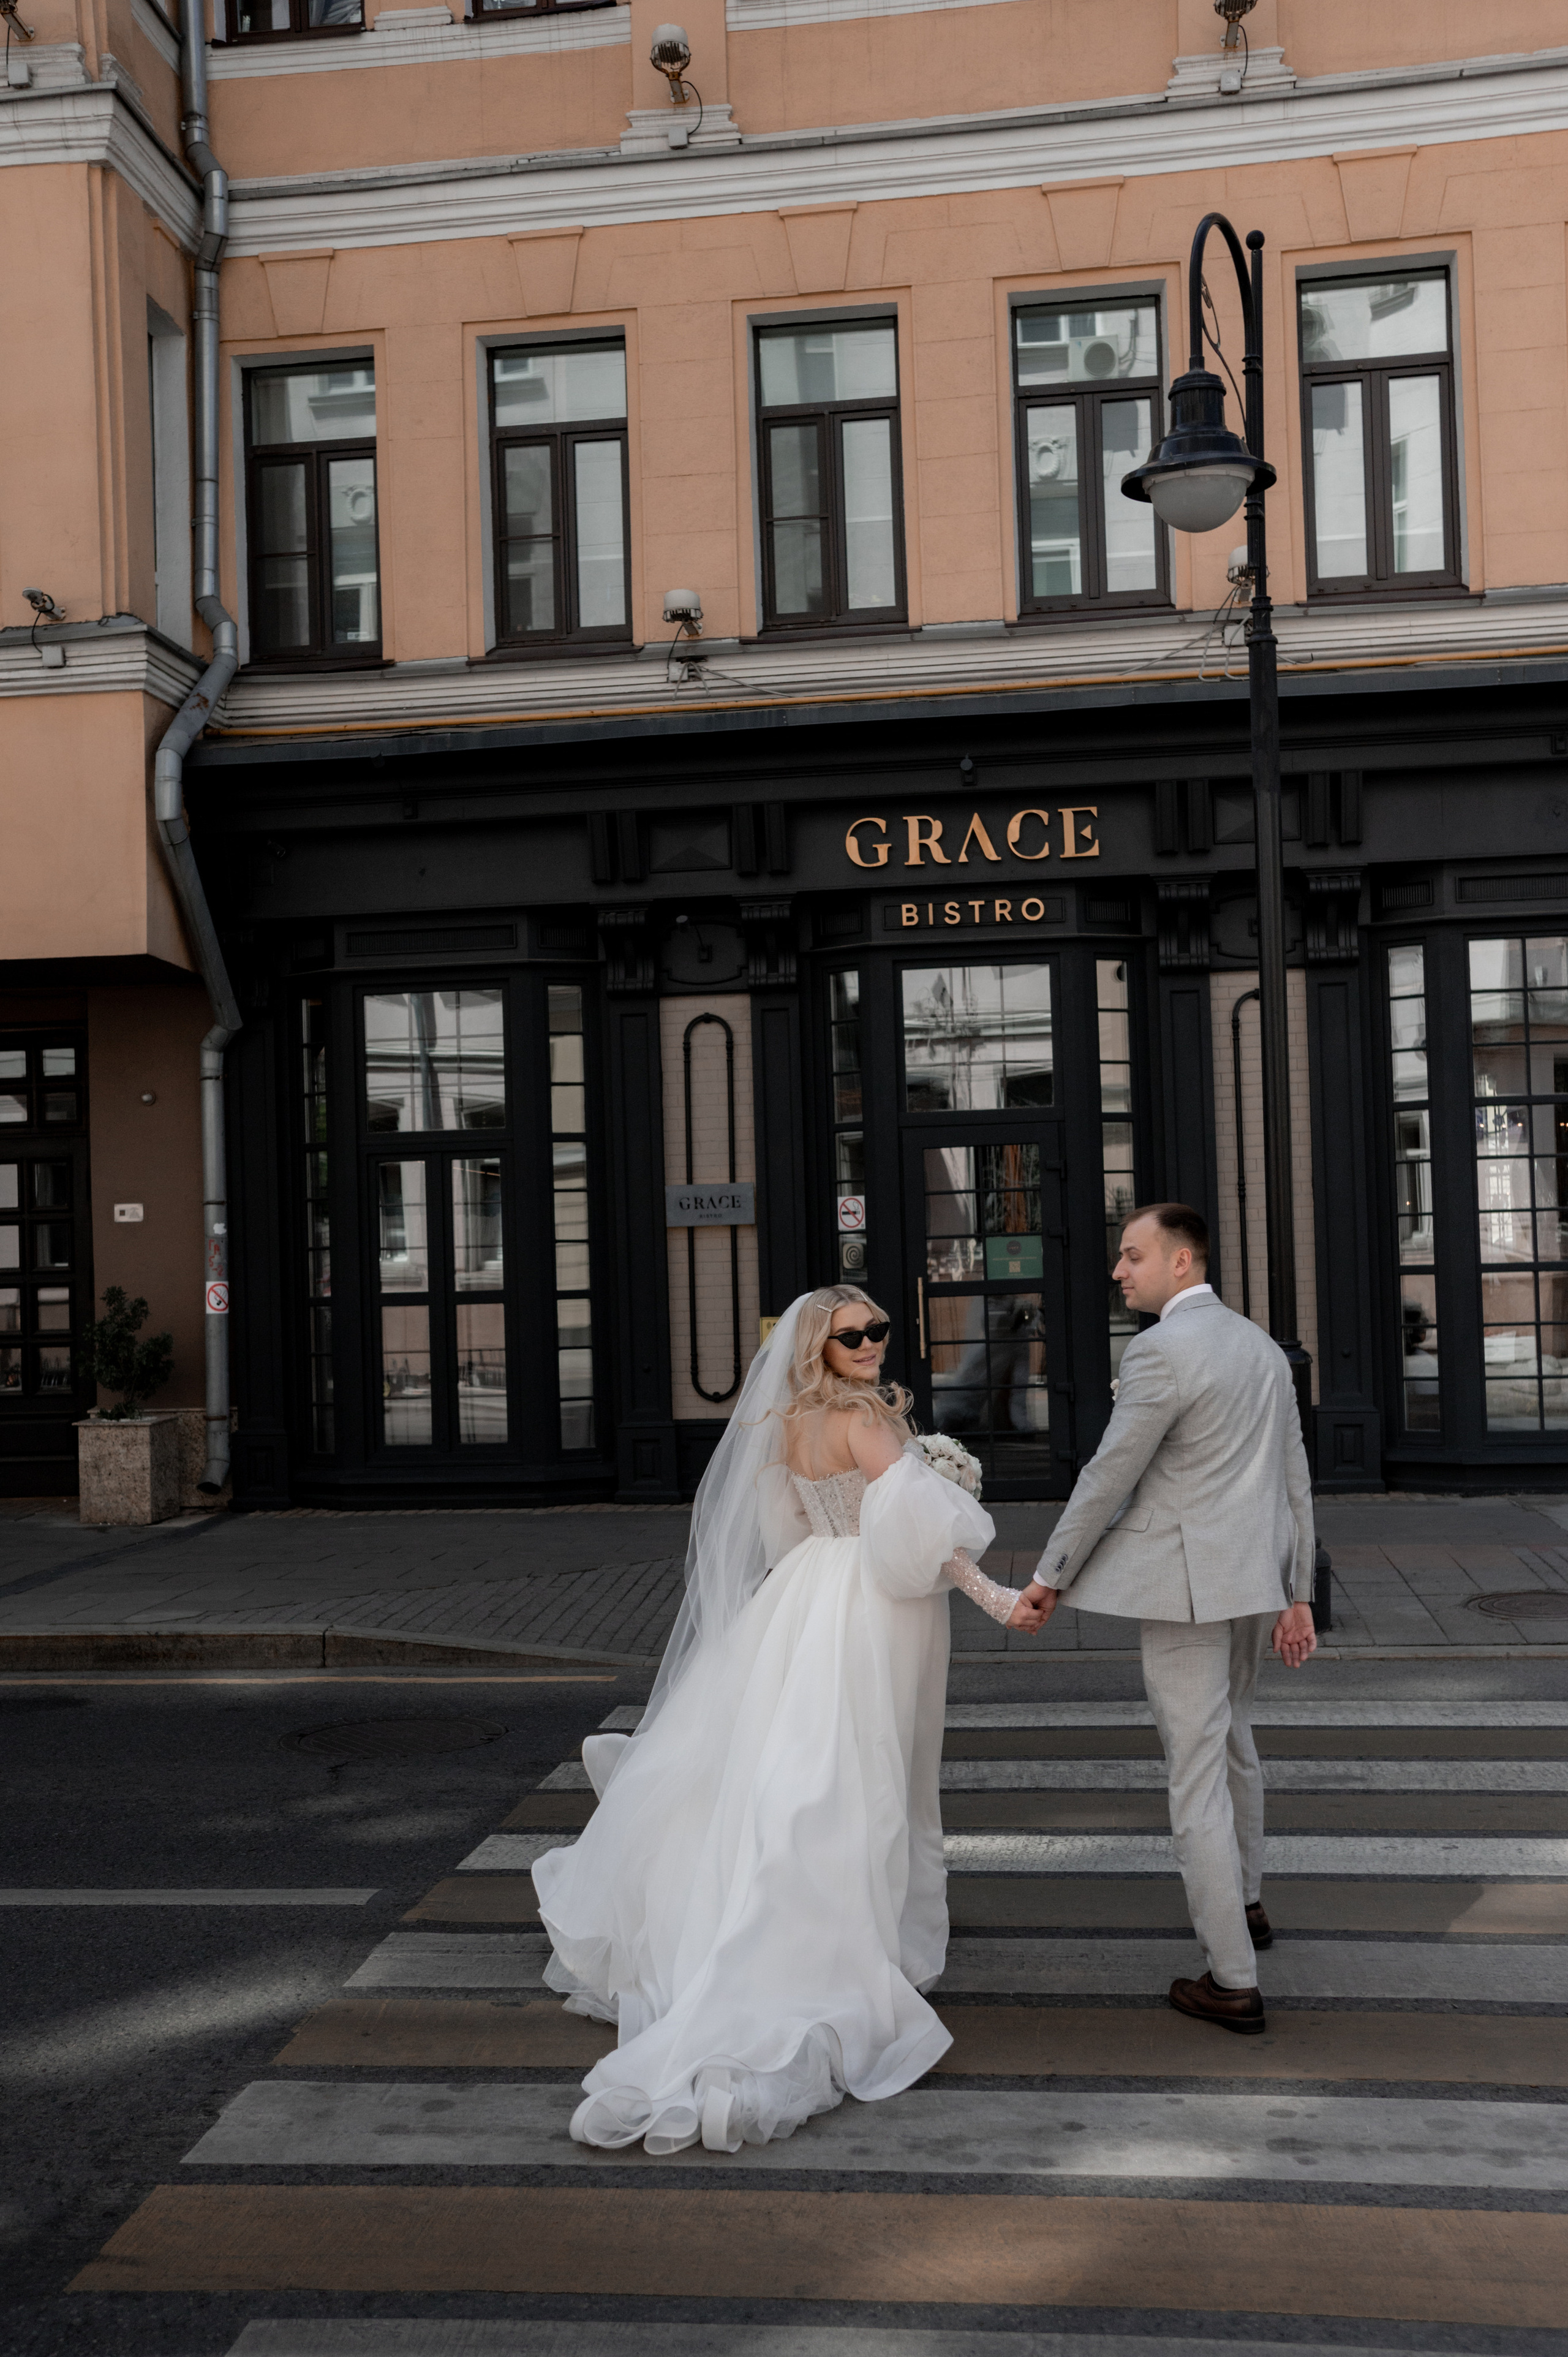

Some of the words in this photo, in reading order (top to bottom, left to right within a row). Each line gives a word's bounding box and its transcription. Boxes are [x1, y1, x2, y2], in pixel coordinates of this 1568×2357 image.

[845, 806, 1099, 868] GRACE
[901, 898, 1045, 926] BISTRO
[679, 1195, 741, 1210] GRACE
